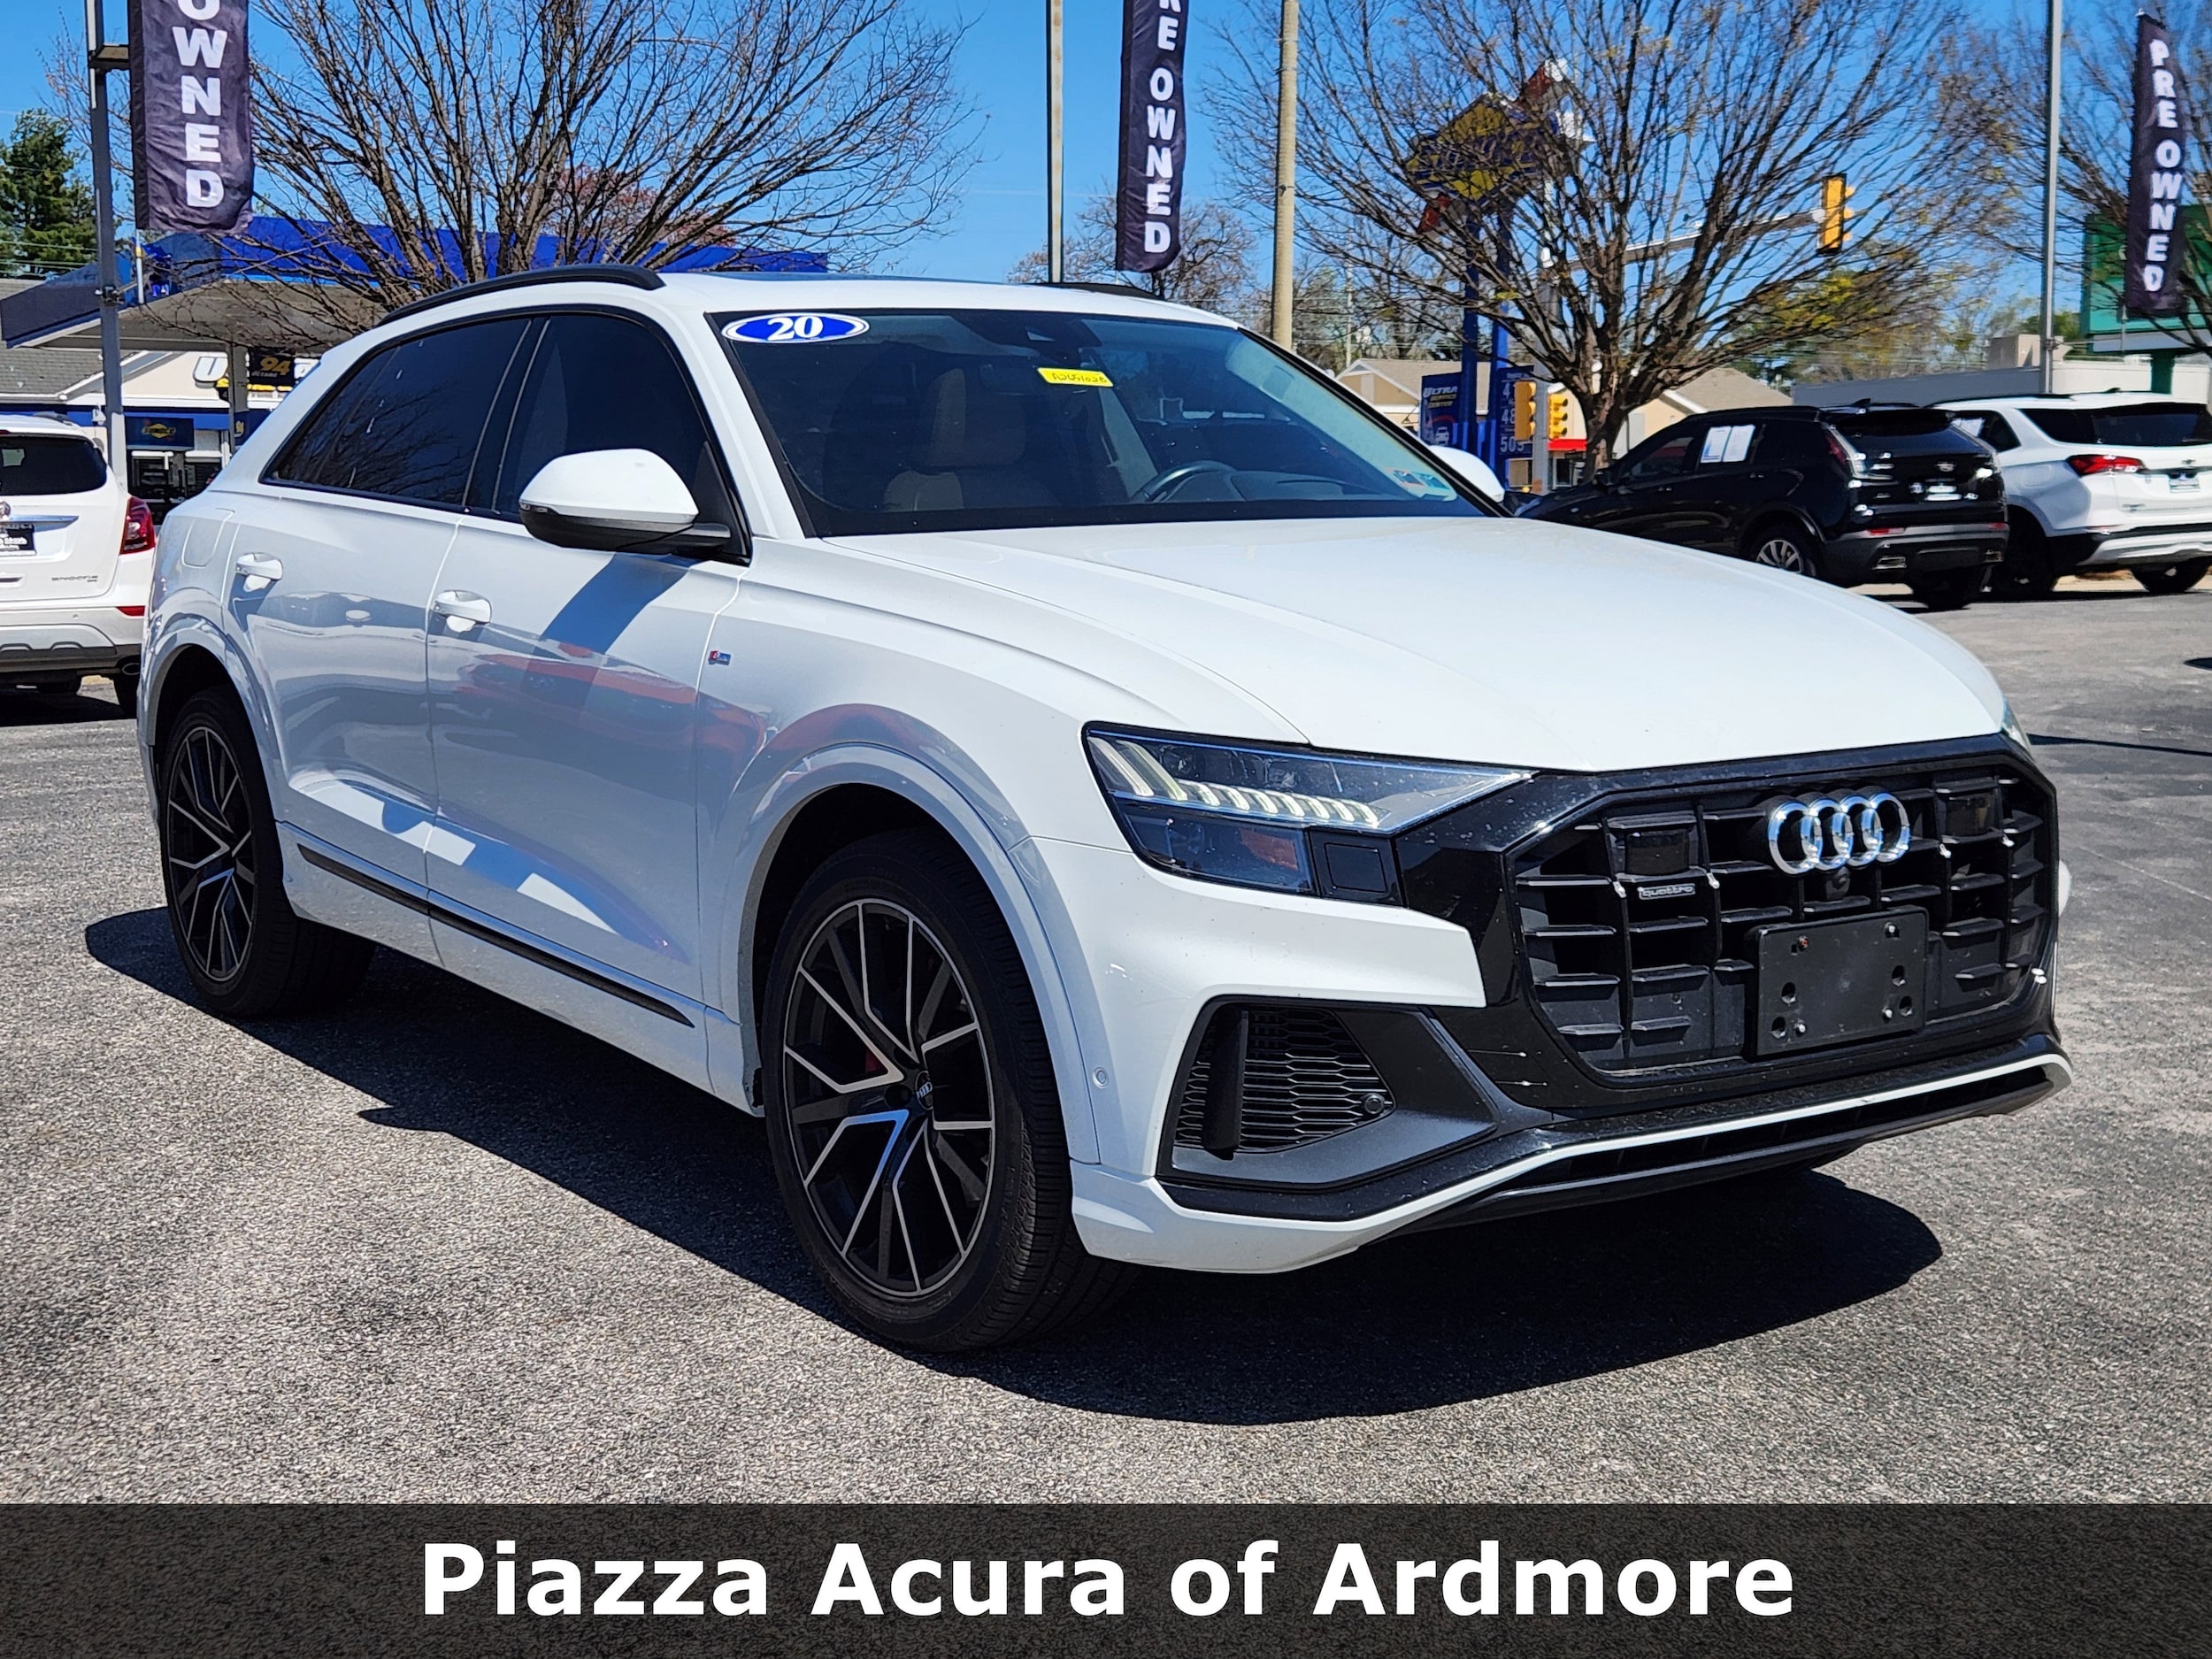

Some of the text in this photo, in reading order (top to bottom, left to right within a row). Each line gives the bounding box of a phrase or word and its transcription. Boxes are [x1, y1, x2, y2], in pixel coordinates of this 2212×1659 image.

[1144, 67, 1176, 253] OWNED
[2143, 38, 2183, 292] PRE OWNED
[767, 316, 824, 341] 20
[260, 357, 292, 376] 94
[1423, 386, 1458, 398] ULTRA
[1642, 885, 1694, 898] quattro
